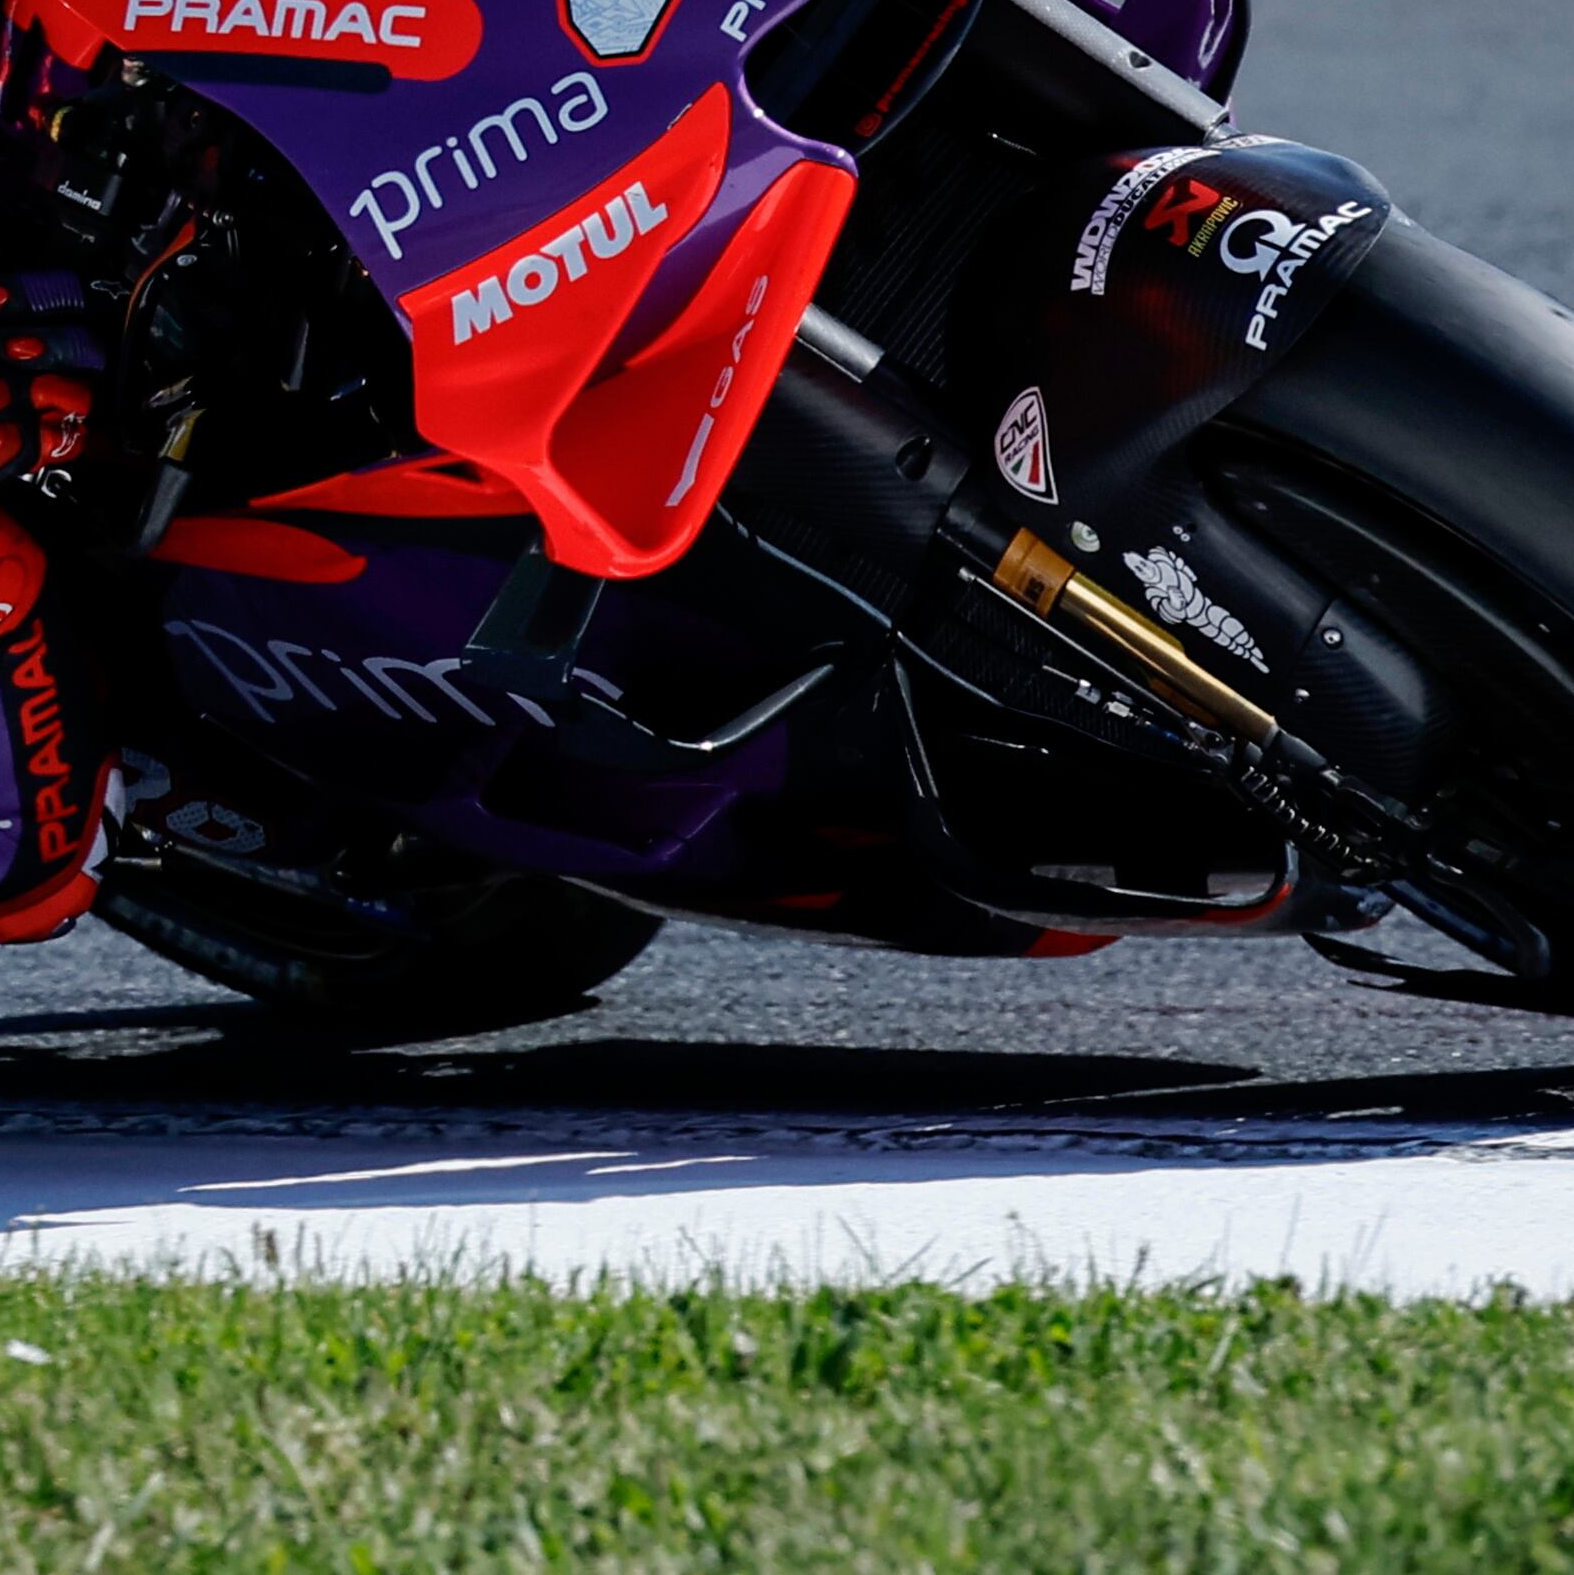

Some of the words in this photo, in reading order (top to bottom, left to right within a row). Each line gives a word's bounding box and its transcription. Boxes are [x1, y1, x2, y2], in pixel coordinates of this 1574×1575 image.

[56, 179, 102, 213] domino
[350, 71, 609, 260] prima
[452, 181, 668, 345] MOTUL
[1244, 200, 1372, 351] PRAMAC
[1004, 424, 1041, 465] RACING
[8, 617, 79, 862] PRAMAC
